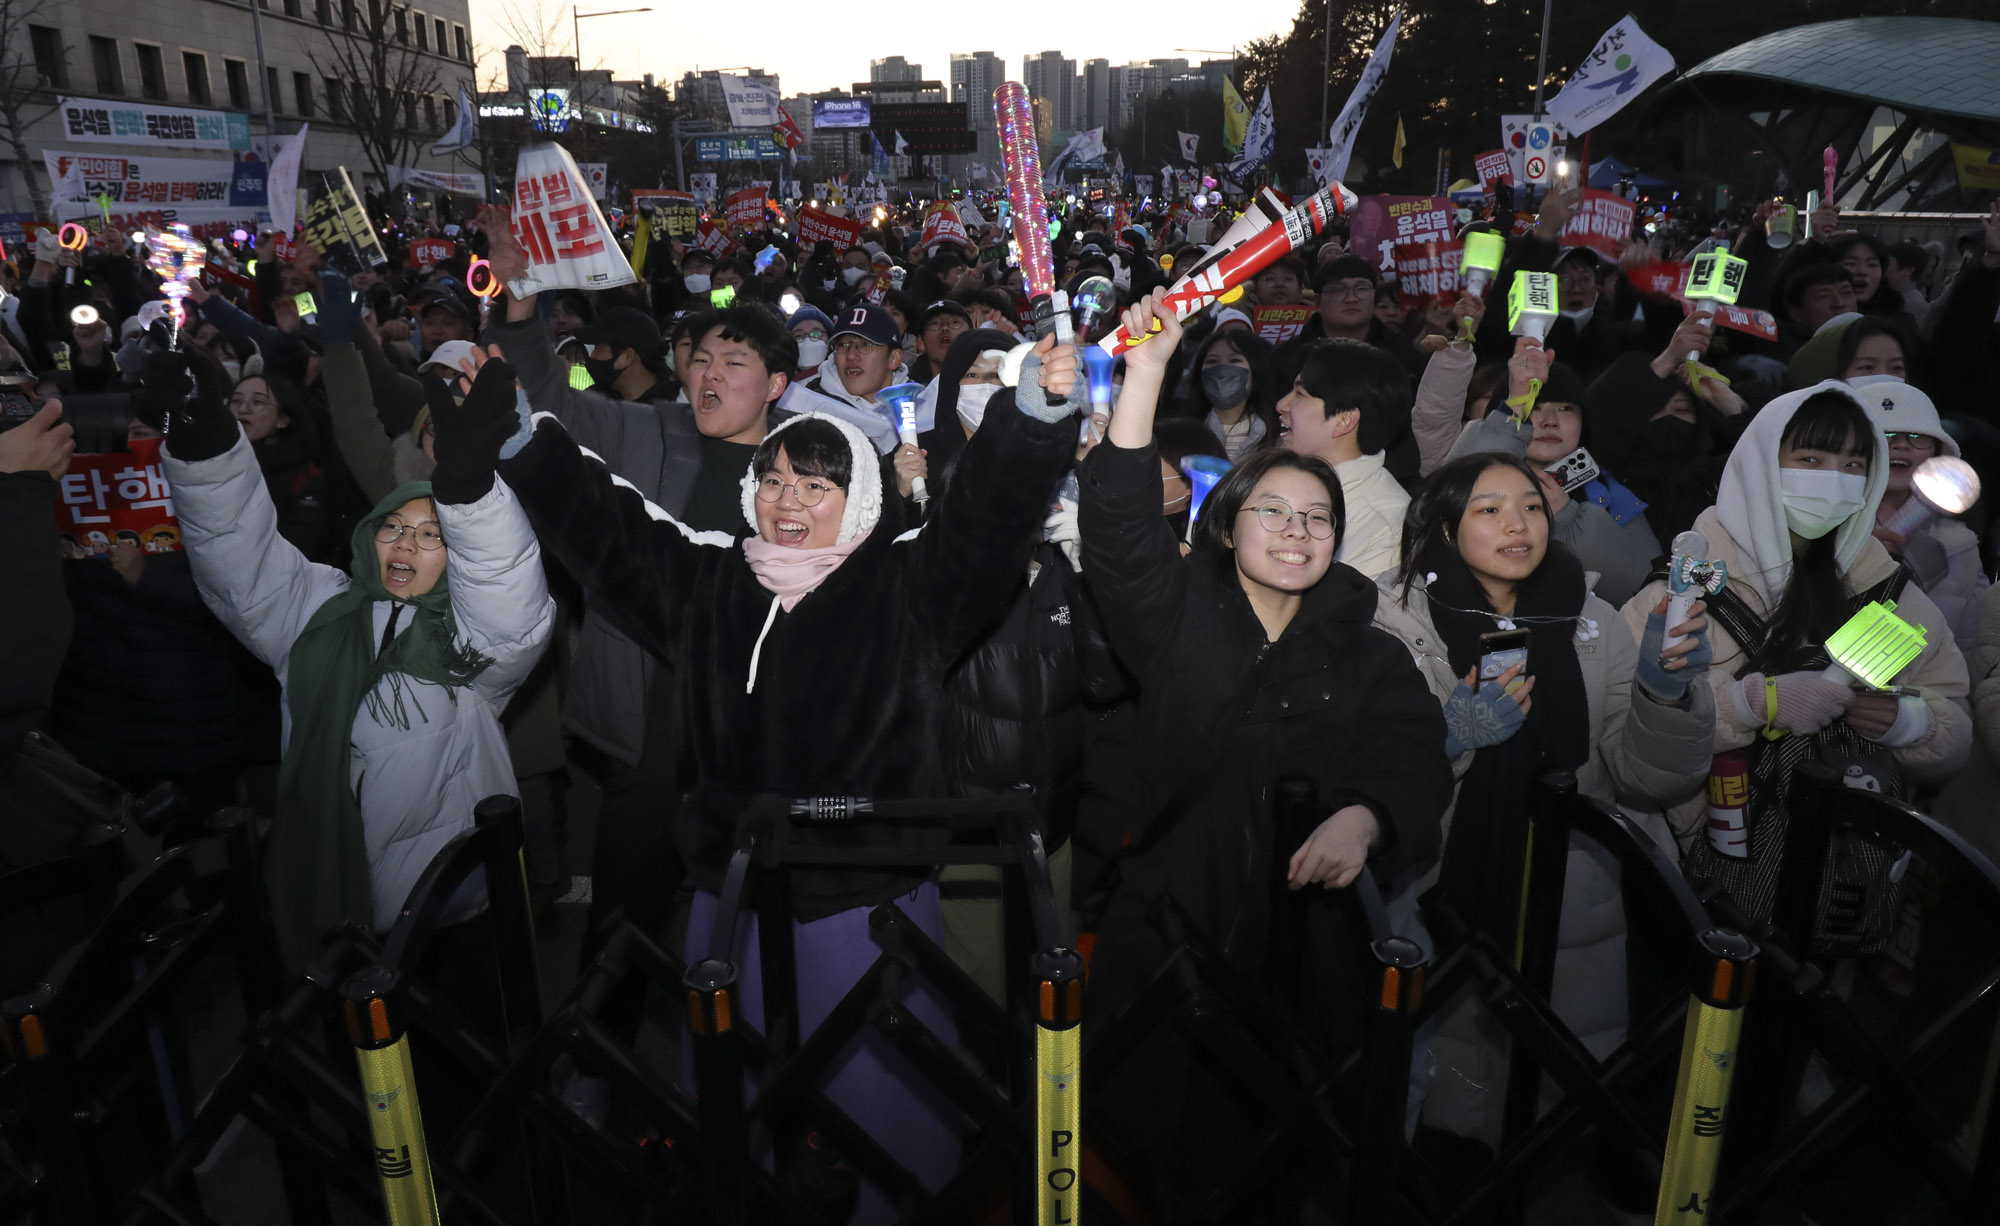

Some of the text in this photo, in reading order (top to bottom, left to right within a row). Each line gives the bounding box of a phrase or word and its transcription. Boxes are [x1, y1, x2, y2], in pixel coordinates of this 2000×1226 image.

[823, 100, 861, 110] iPhone 16
[65, 108, 112, 136] 윤석열
[1474, 151, 1508, 170] 국민의힘
[1478, 162, 1511, 189] 하라
[123, 181, 169, 202] 윤석열
[170, 181, 227, 202] 탄핵하라!
[743, 197, 762, 211] 윤석열
[1388, 198, 1433, 217] 반란수괴
[738, 207, 763, 222] 처단하라
[1396, 209, 1449, 236] 윤석열
[667, 214, 698, 237] 탄핵
[1558, 210, 1632, 240] 체하라!
[827, 226, 853, 245] 윤석열
[416, 244, 448, 264] 탄핵
[1399, 267, 1467, 297] 해체하
[1692, 259, 1745, 294] 탄핵
[850, 308, 868, 326] D
[1256, 308, 1308, 322] 내란수괴
[60, 463, 178, 524] 탄핵
